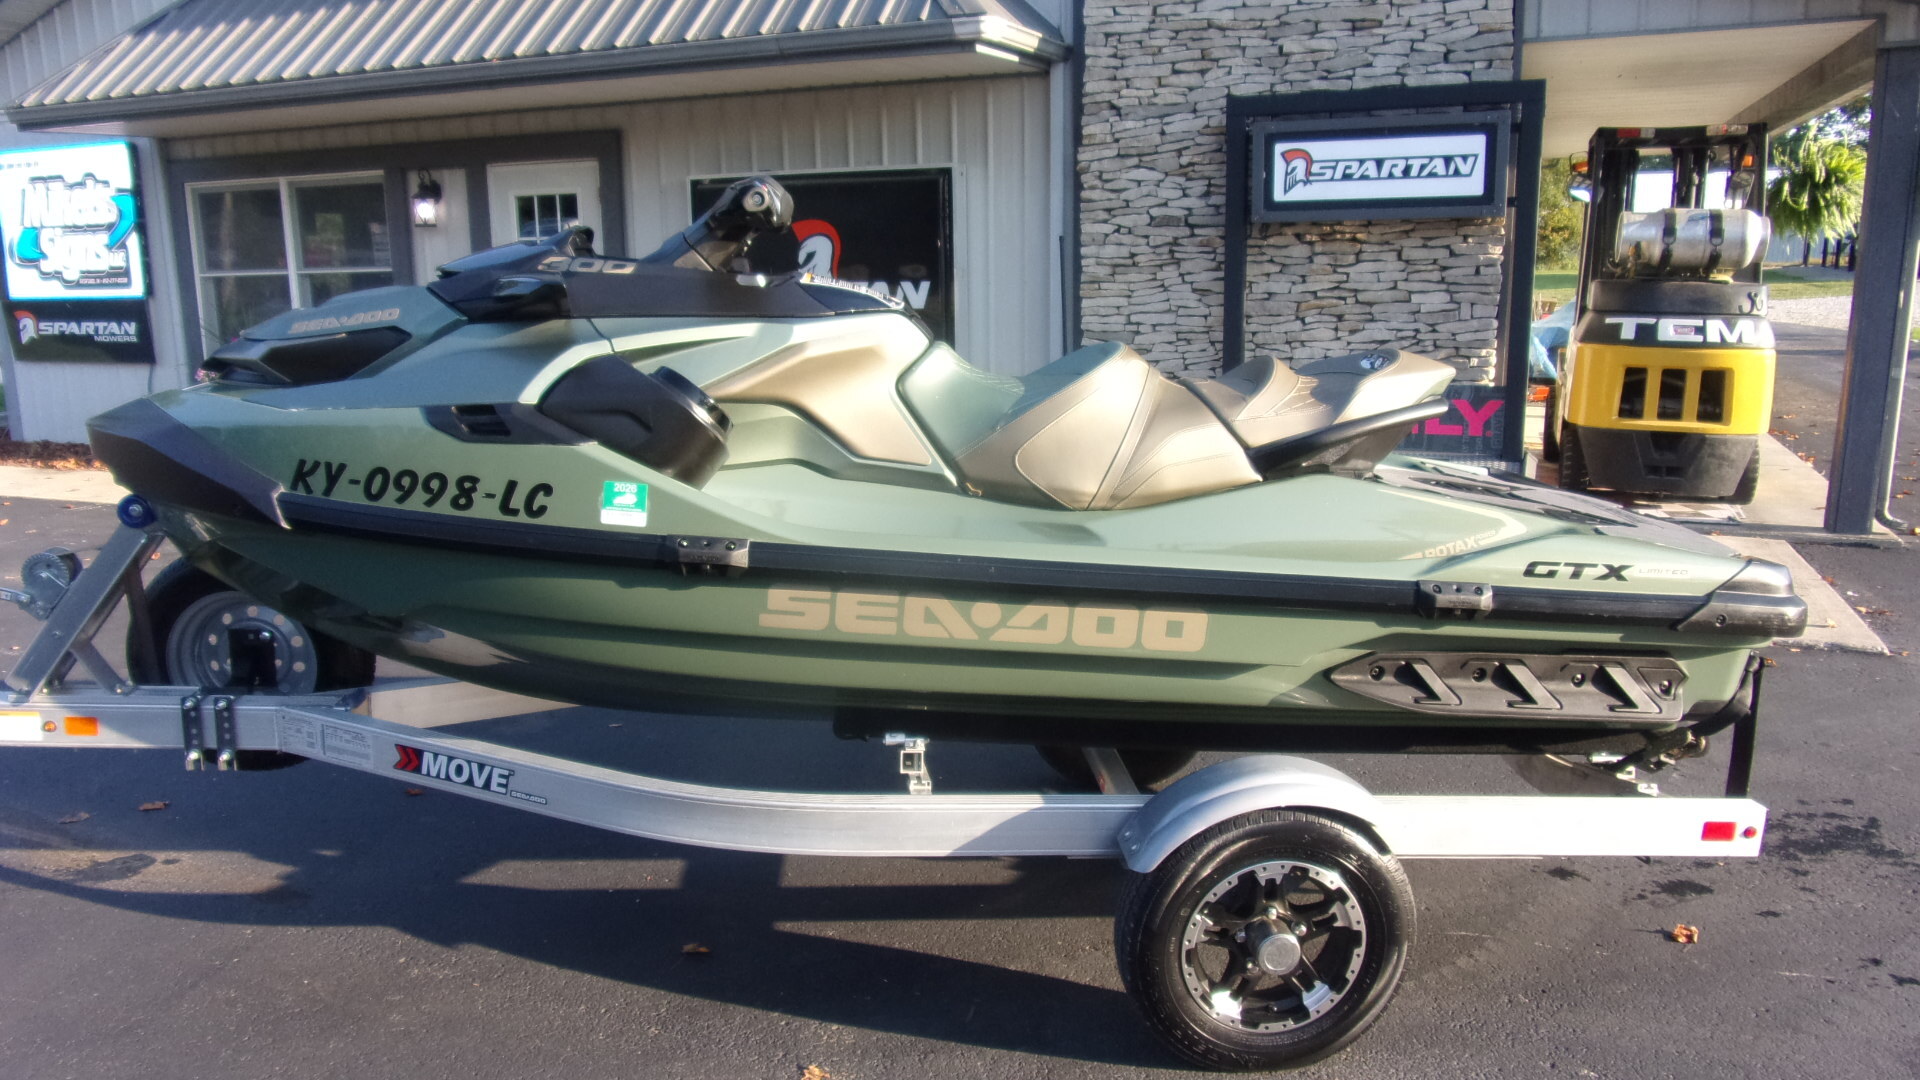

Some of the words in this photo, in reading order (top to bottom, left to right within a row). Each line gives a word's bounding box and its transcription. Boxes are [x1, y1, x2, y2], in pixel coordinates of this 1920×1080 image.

[1308, 155, 1478, 181] SPARTAN
[538, 256, 638, 274] 300
[38, 322, 136, 335] SPARTAN
[1605, 317, 1774, 345] TCM
[290, 458, 554, 519] KY-0998-LC
[1522, 561, 1634, 582] GTX
[421, 751, 510, 794] MOVE
